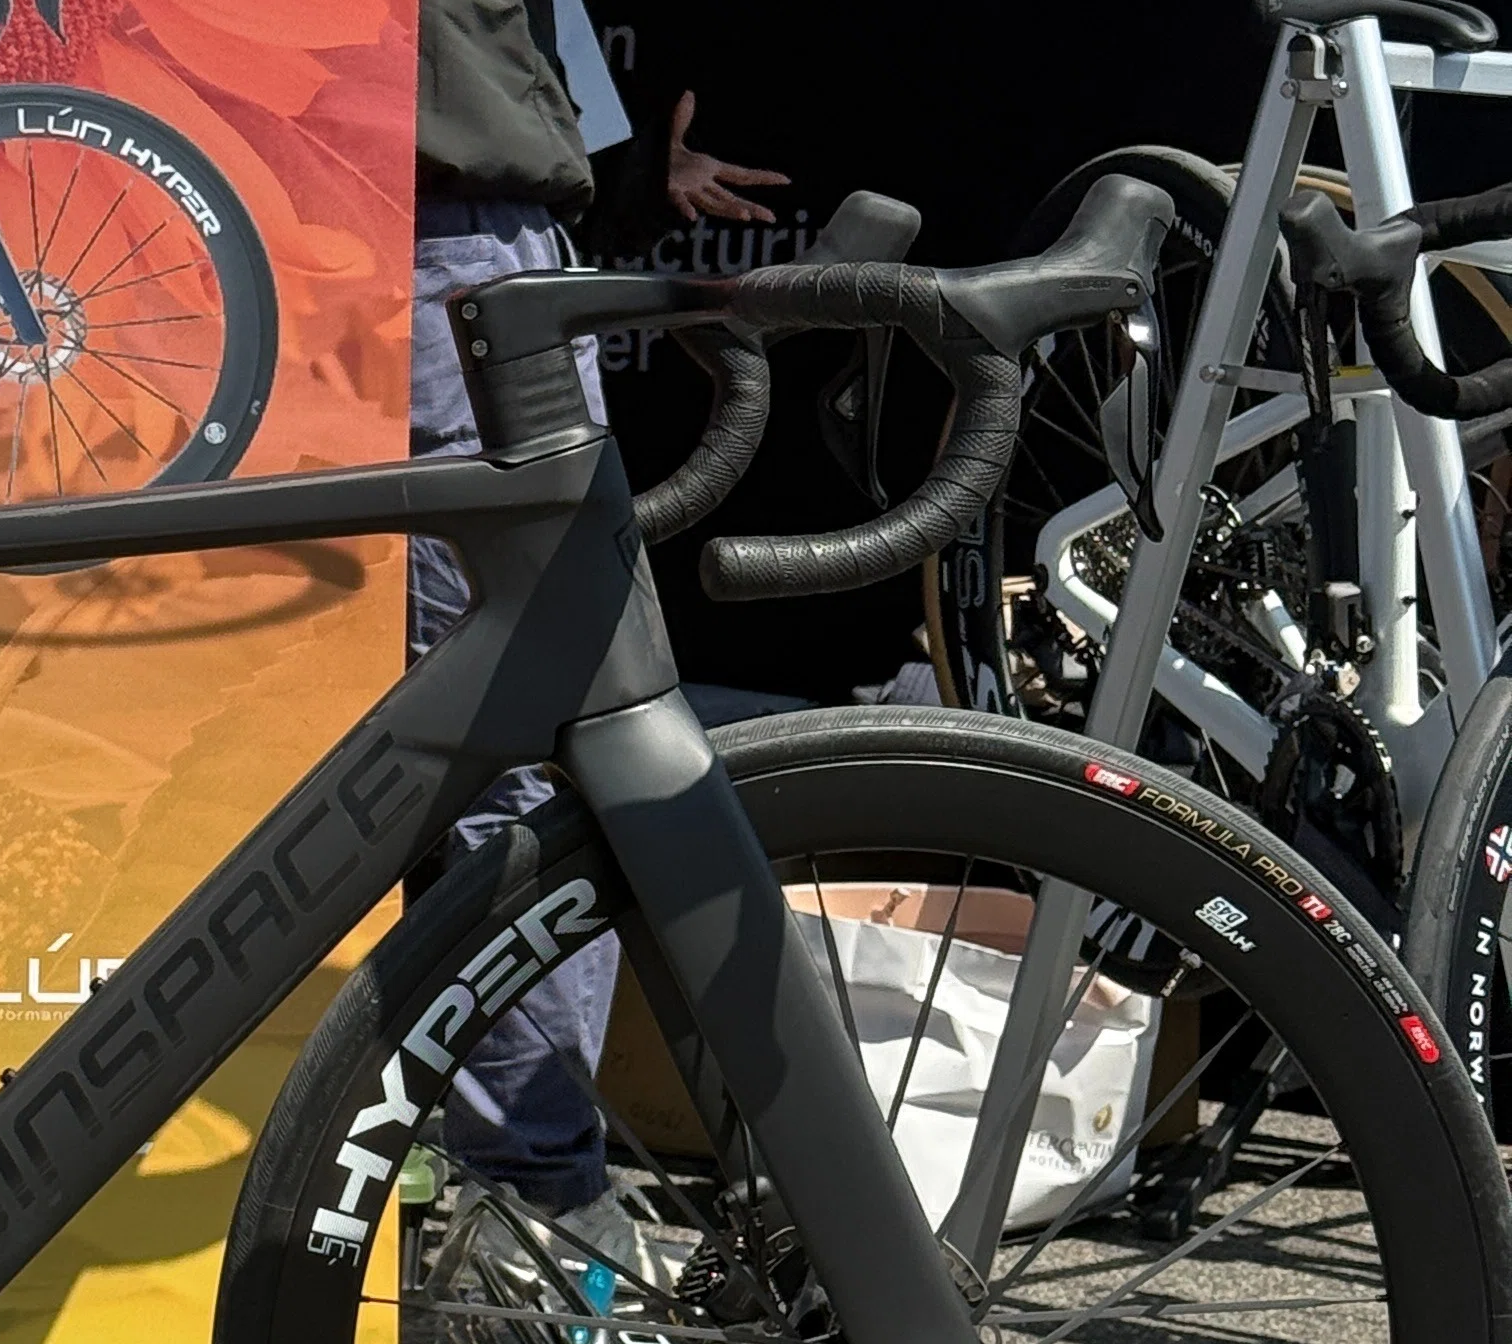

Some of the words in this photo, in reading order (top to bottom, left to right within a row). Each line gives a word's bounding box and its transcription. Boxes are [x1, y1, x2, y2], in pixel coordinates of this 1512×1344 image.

[120, 137, 223, 238] HYPER
[1138, 786, 1253, 860] FORMULA
[1252, 855, 1305, 897] PRO
[1300, 894, 1326, 921] TL
[1207, 898, 1245, 926] D45
[1476, 916, 1494, 956] IN
[311, 877, 609, 1243] HYPER
